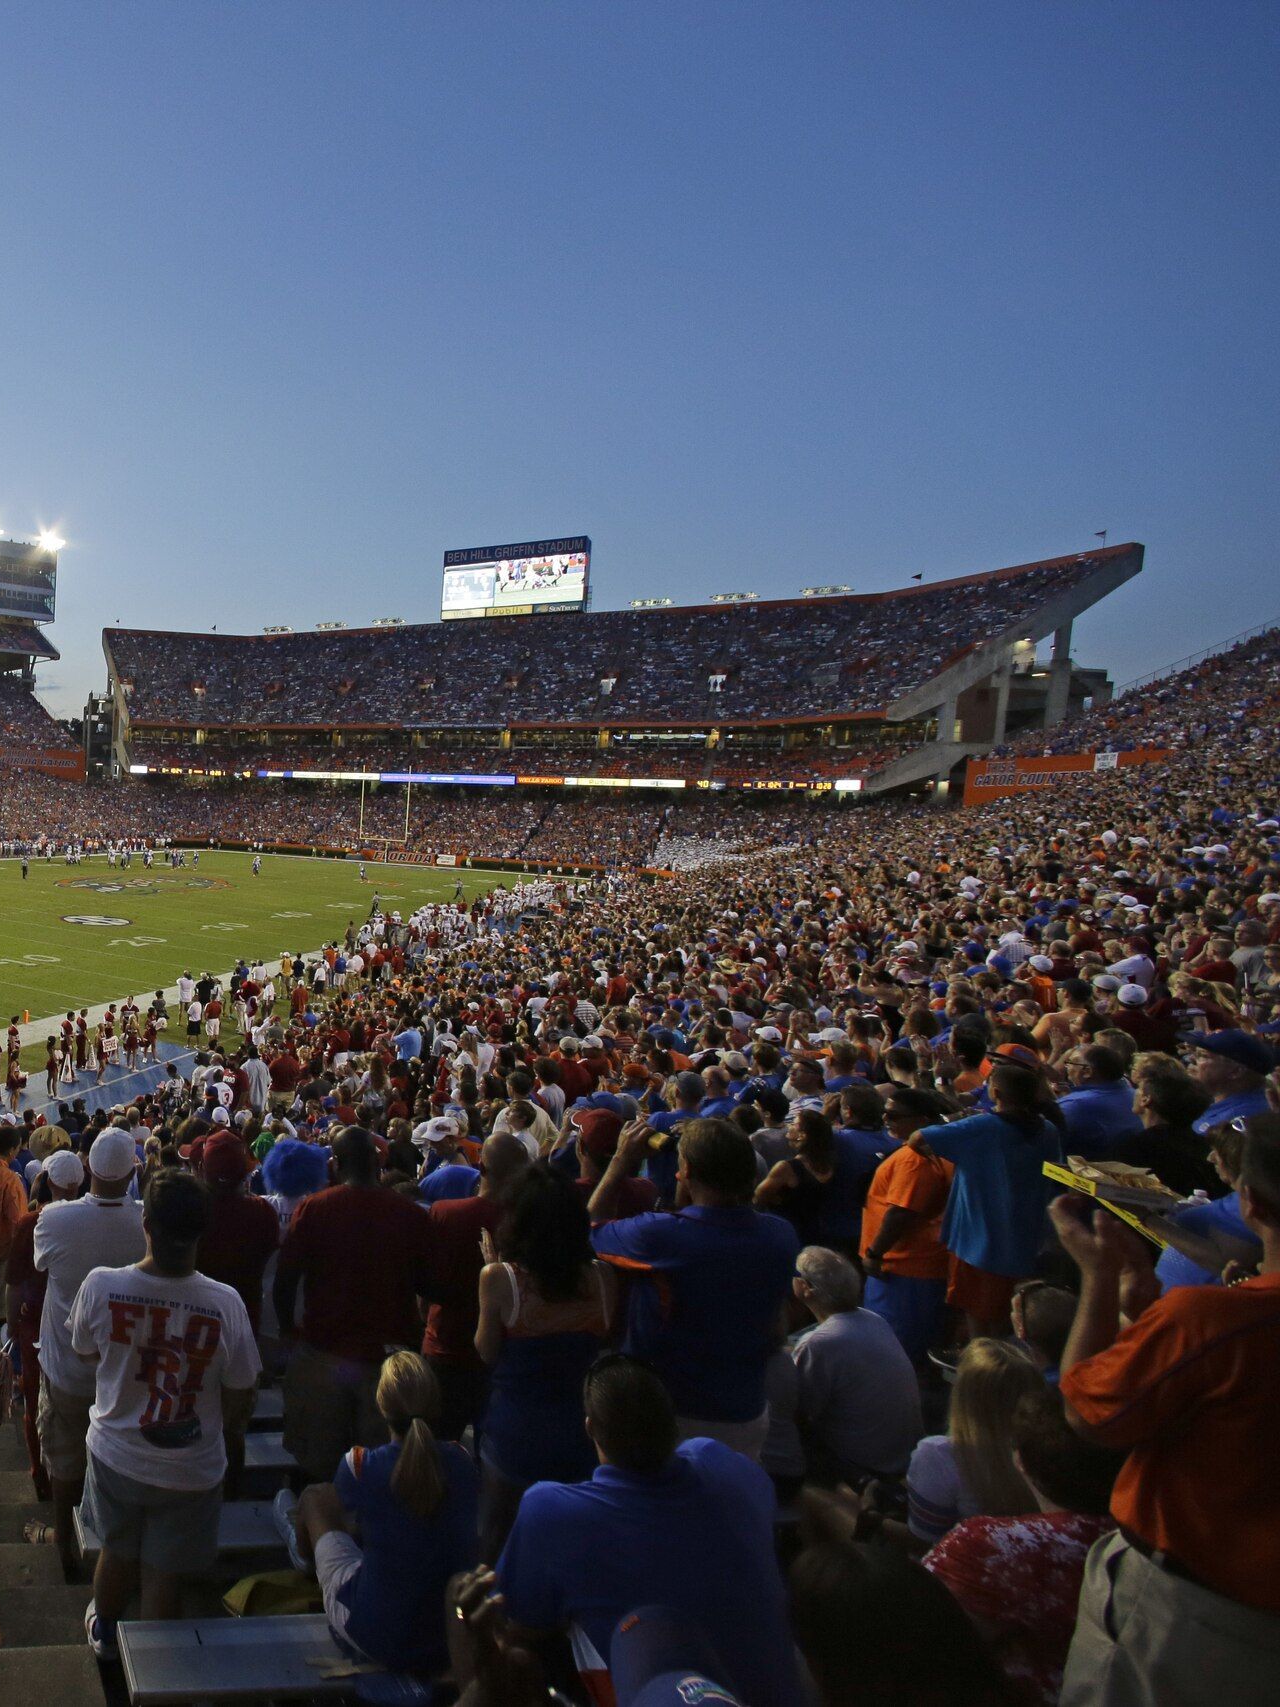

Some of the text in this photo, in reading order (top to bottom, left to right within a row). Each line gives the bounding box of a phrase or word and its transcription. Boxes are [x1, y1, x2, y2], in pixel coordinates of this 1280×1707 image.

[447, 538, 584, 563] BEN HILL GRIFFIN STADIUM
[974, 774, 1015, 787] GATOR
[108, 936, 168, 947] 20
[109, 1292, 223, 1320] UNIVERSITY OF FLORIDA
[108, 1301, 223, 1360] FLO
